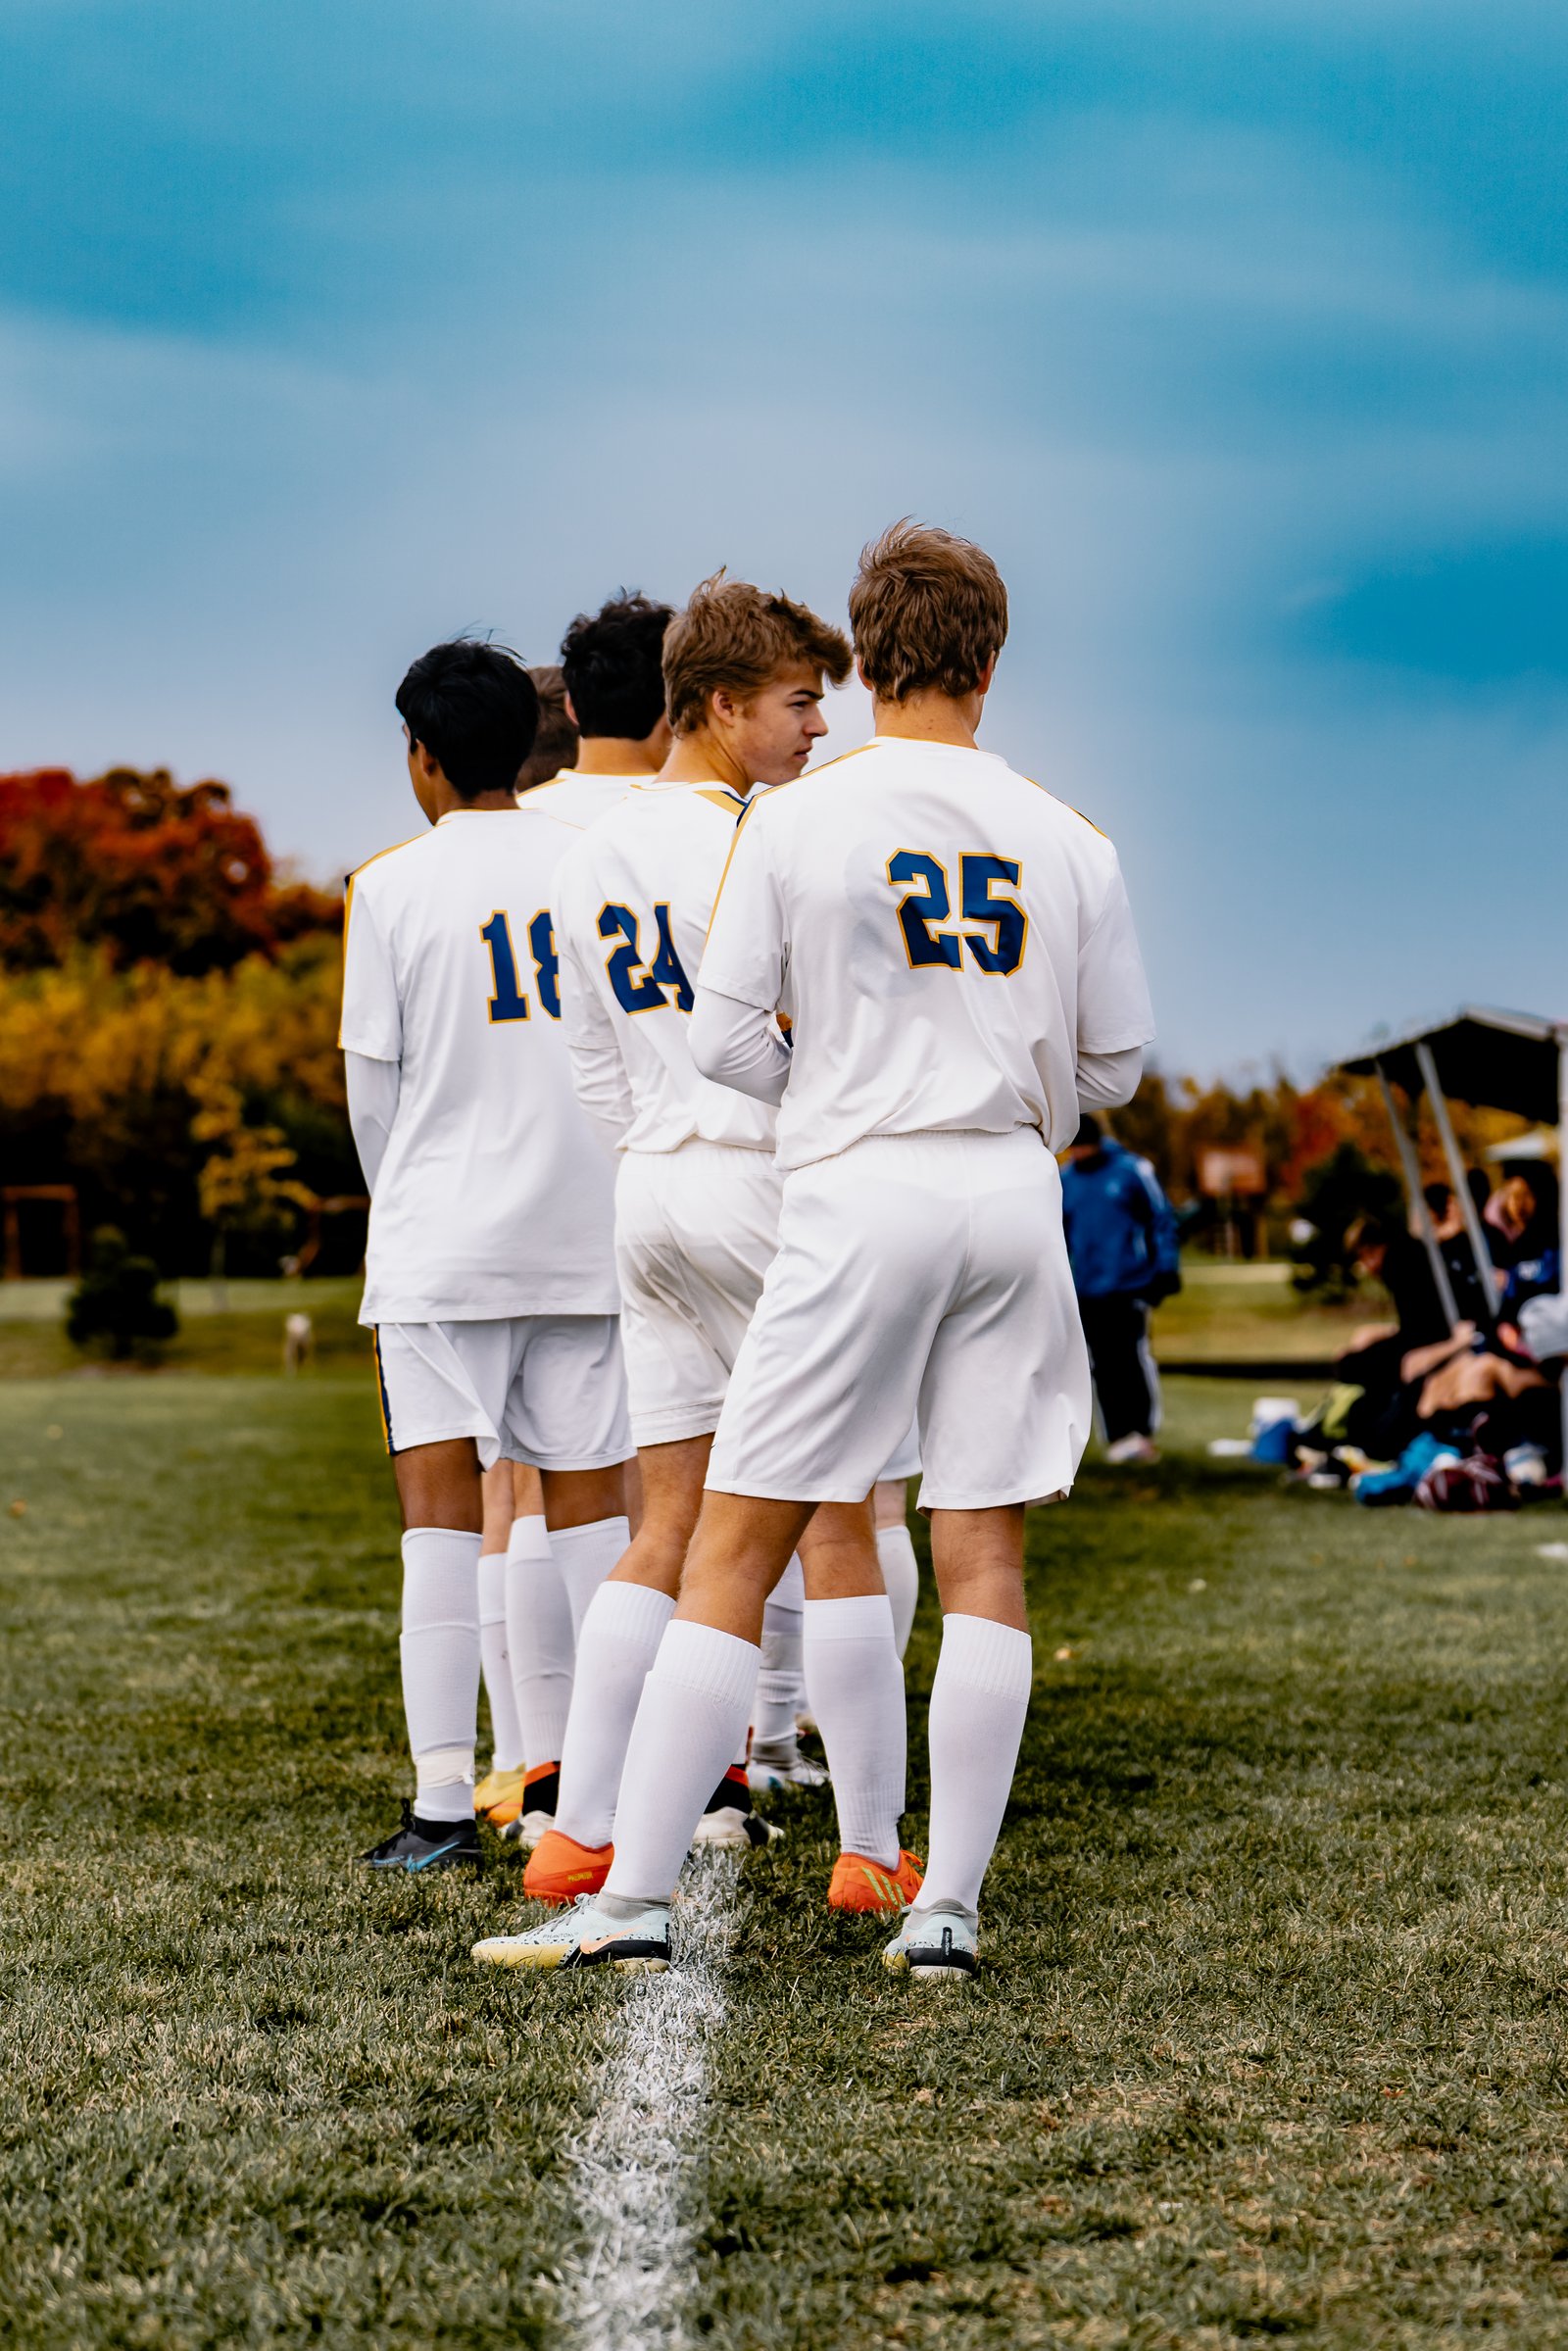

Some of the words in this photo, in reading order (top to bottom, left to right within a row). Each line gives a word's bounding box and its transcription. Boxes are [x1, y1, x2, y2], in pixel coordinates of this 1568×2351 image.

[478, 907, 562, 1024] 18
[595, 901, 696, 1016] 24
[885, 848, 1029, 978] 25
